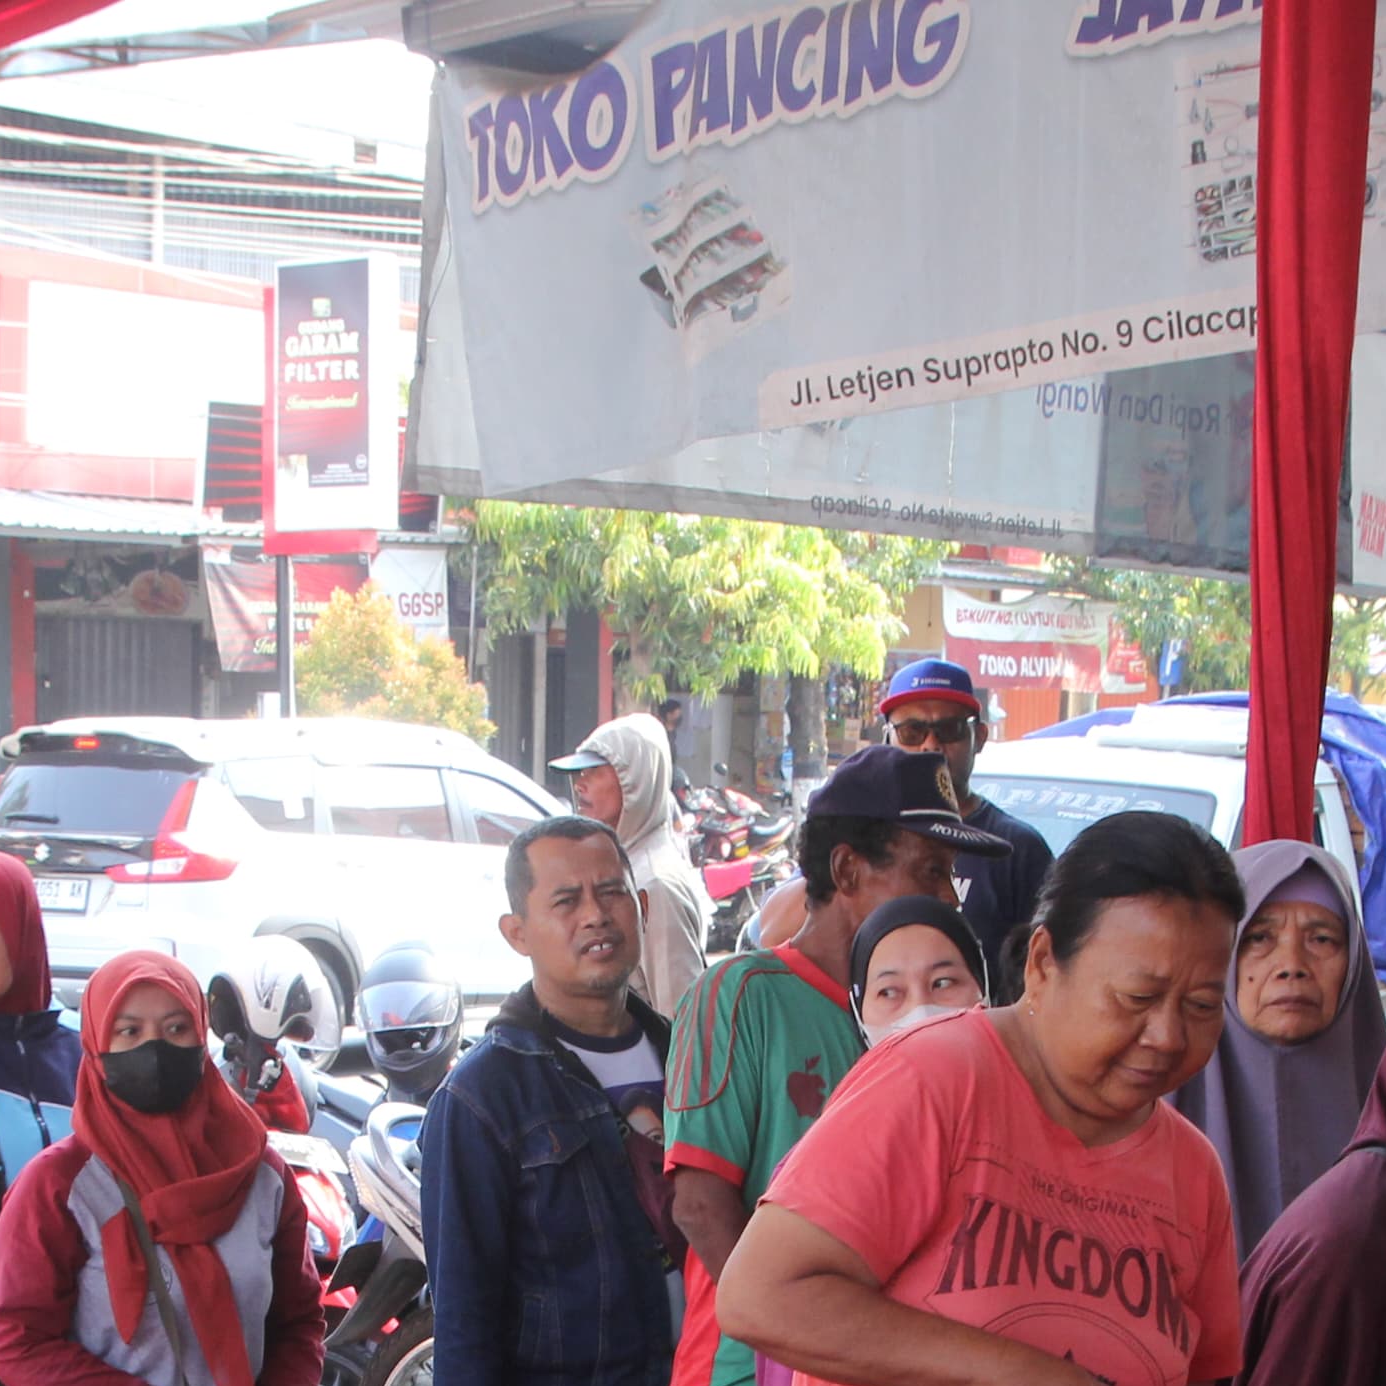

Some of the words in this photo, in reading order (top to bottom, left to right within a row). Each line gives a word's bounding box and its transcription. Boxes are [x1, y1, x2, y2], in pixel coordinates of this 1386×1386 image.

[468, 61, 628, 204] TOKO
[650, 0, 960, 153] PANCING
[284, 358, 360, 384] FILTER
[285, 330, 360, 358] GARAM
[790, 381, 821, 407] Jl.
[826, 362, 916, 403] Letjen
[922, 338, 1055, 387] Suprapto
[1061, 329, 1109, 360] No.
[1116, 319, 1134, 348] 9
[978, 653, 1018, 677] TOKO
[935, 1197, 1191, 1354] KINGDOM
